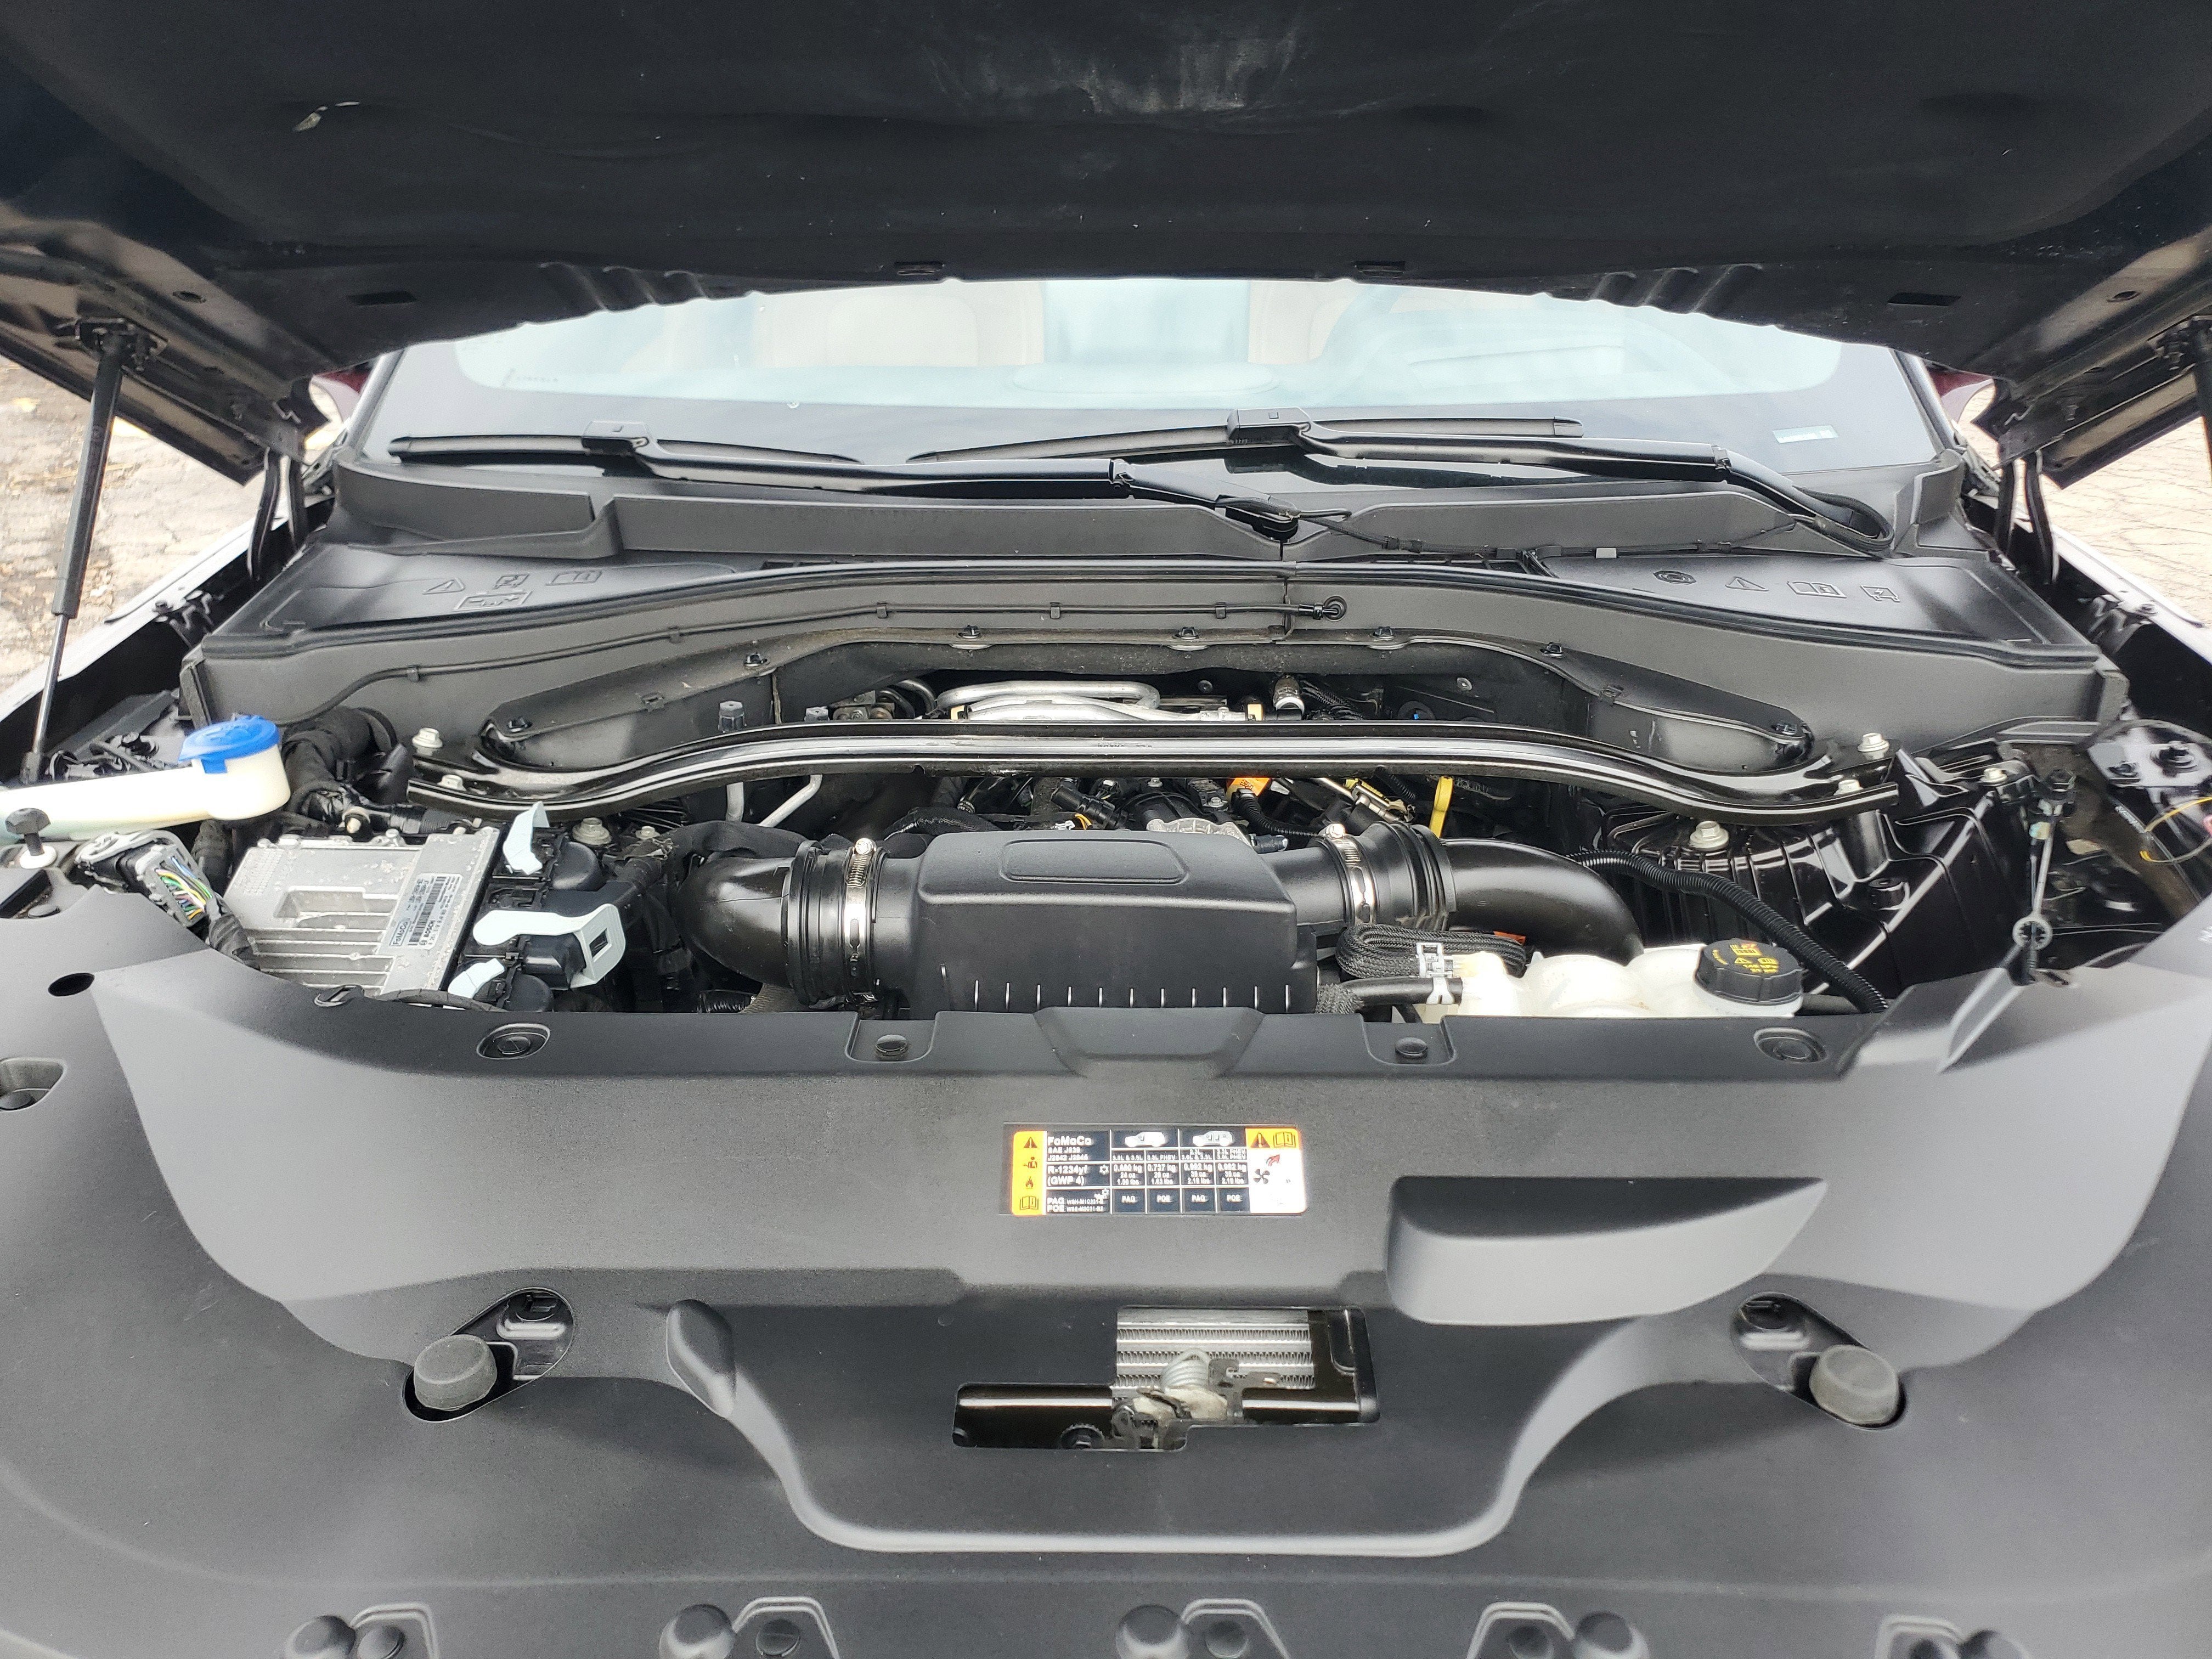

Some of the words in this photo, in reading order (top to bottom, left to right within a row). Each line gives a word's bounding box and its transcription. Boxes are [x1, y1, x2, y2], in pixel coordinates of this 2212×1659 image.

[423, 920, 436, 938] BOSCH
[1047, 1135, 1092, 1146] FoMoCo
[1047, 1165, 1088, 1176] R-1234yf
[1133, 1164, 1143, 1173] kg
[1167, 1163, 1176, 1173] kg
[1203, 1163, 1212, 1172] kg
[1237, 1163, 1246, 1172] kg
[1047, 1176, 1074, 1186] (GWP
[1075, 1175, 1085, 1186] 4)
[1047, 1204, 1065, 1212] POE
